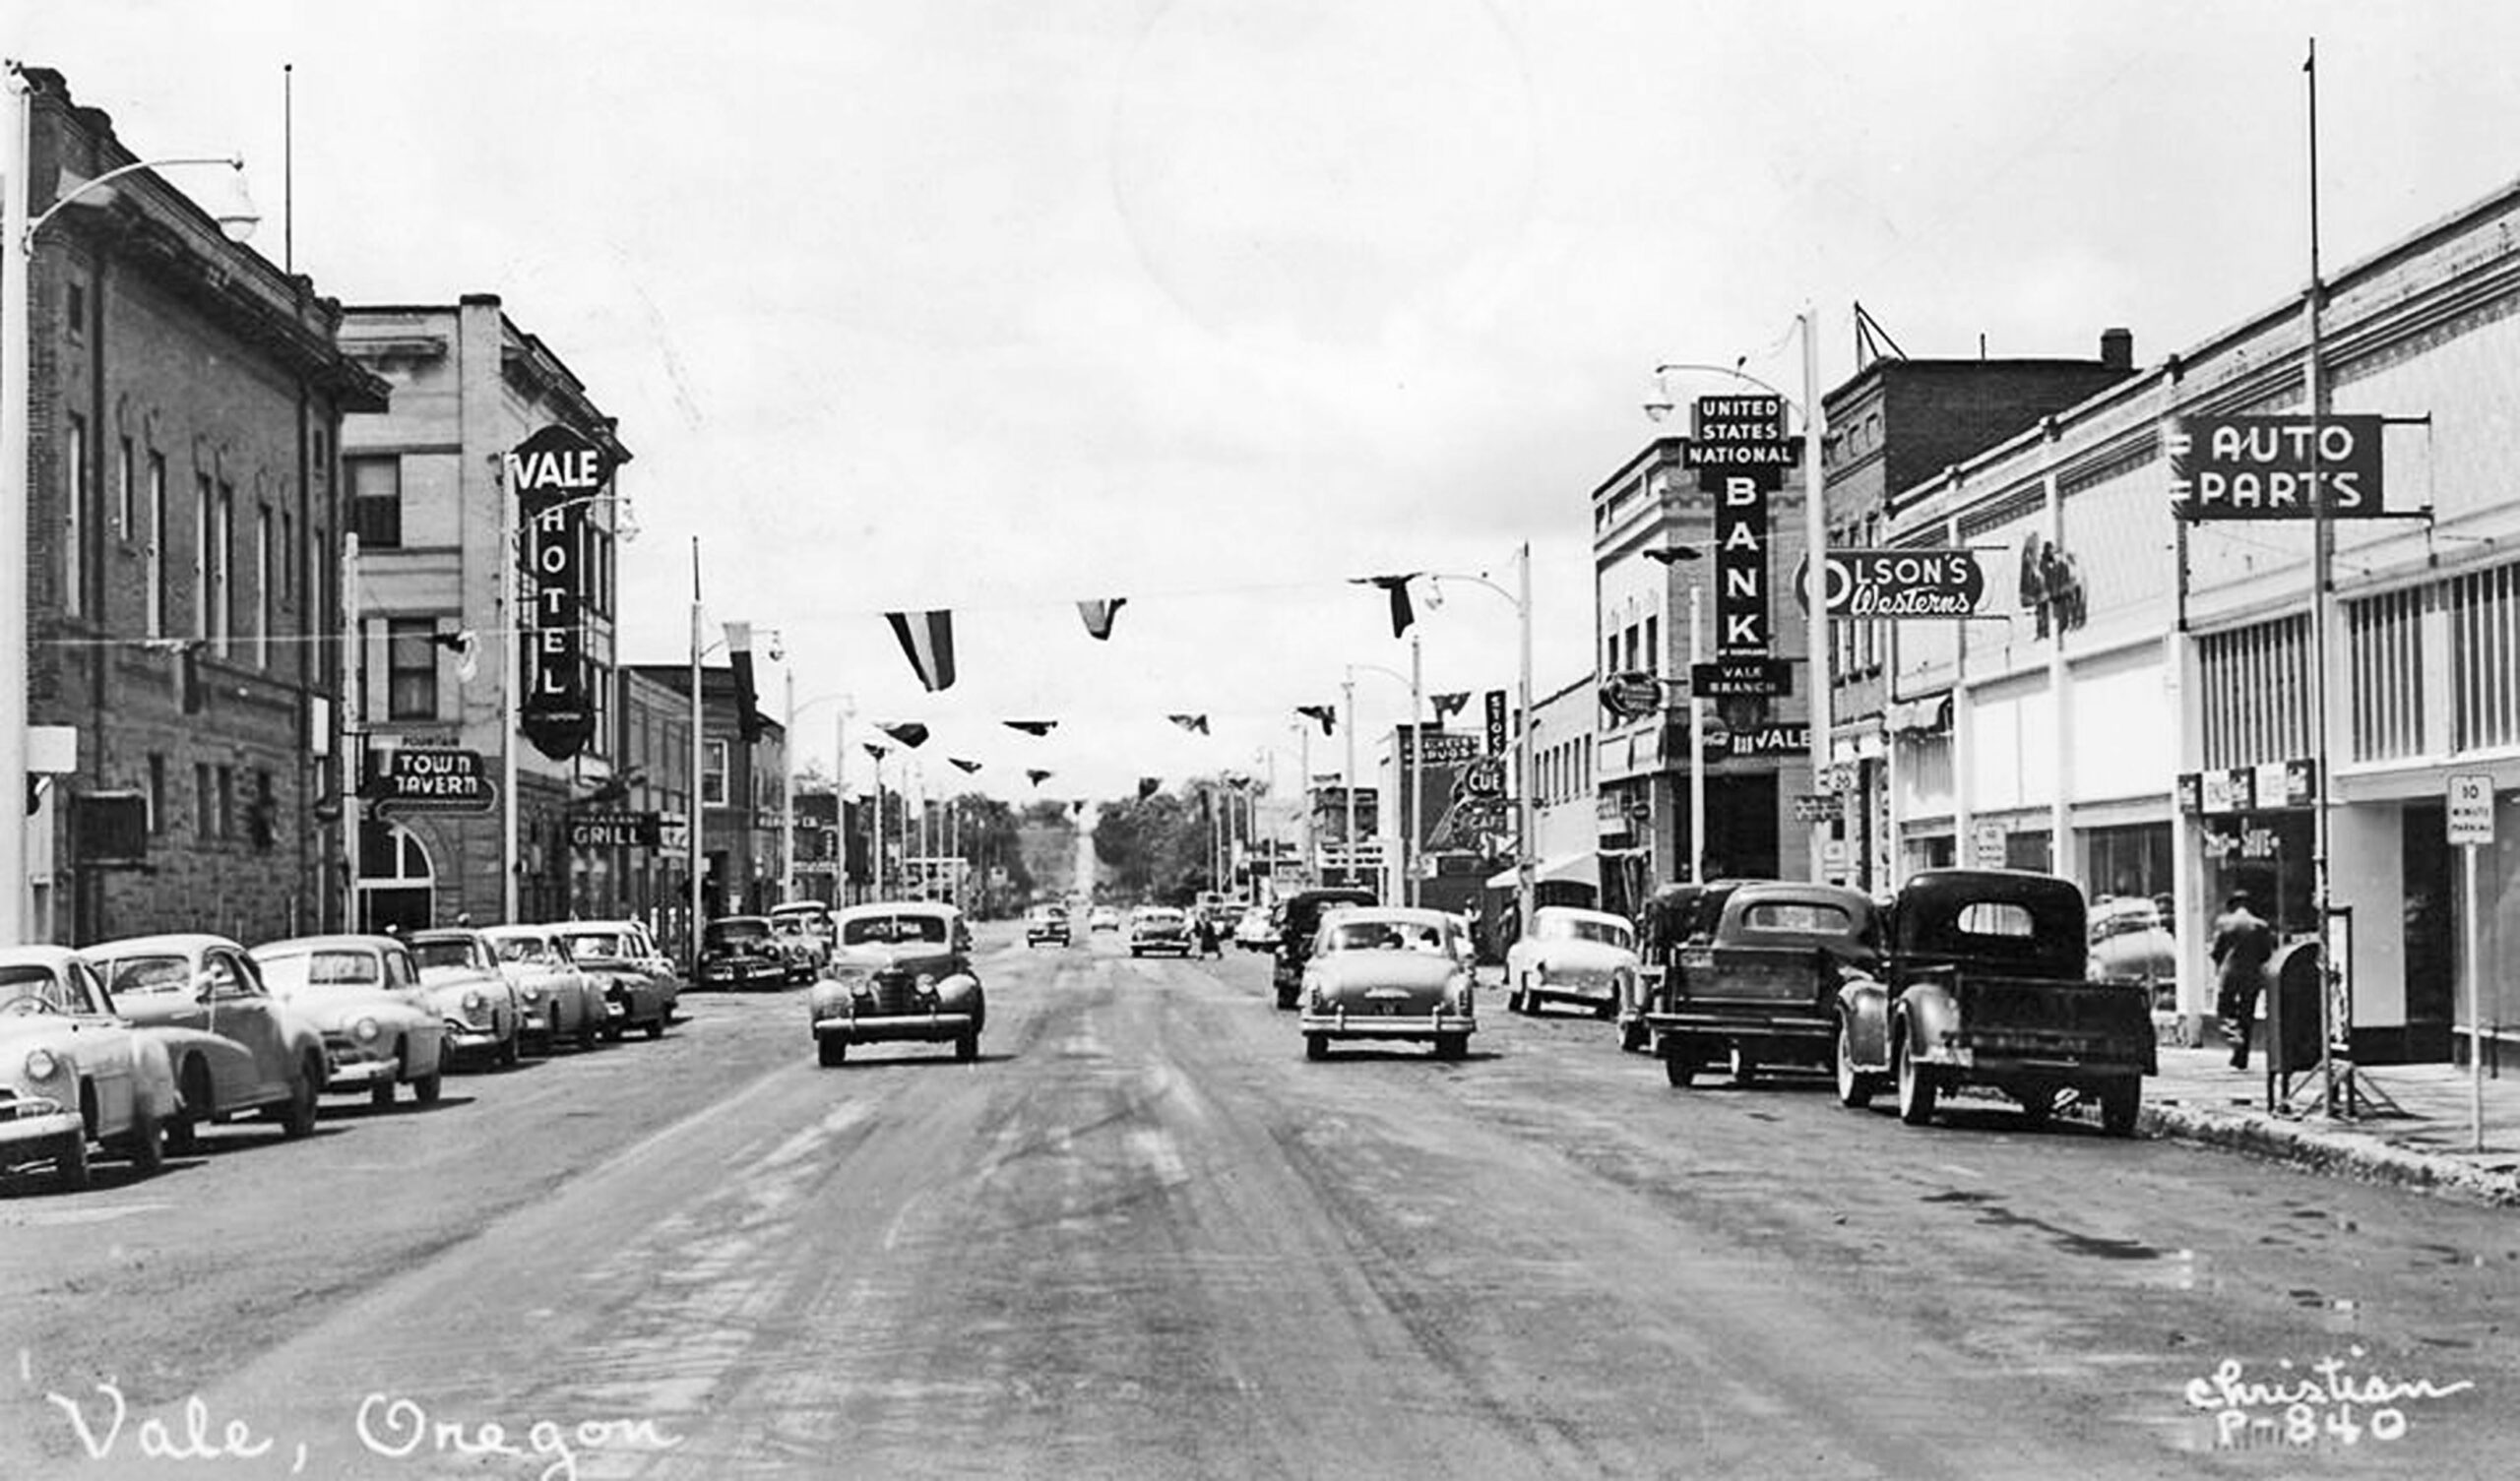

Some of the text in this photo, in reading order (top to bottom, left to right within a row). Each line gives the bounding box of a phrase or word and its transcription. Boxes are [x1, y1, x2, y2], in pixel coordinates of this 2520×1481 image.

[1703, 400, 1779, 416] UNITED
[1703, 423, 1779, 440] STATES
[2212, 425, 2355, 463] AUTO
[1689, 448, 1792, 463] NATIONAL
[512, 451, 598, 489] VALE
[2199, 471, 2362, 508] PARTS
[1726, 476, 1760, 644] BANK
[542, 507, 567, 694] HOTEL
[1851, 584, 1970, 616] Westerns
[1722, 666, 1762, 678] VALE
[1709, 681, 1777, 694] BRANCH
[1755, 729, 1811, 749] VALE
[399, 754, 472, 774] TOWN
[395, 775, 478, 794] TAVERN
[573, 826, 640, 844] GRILL
